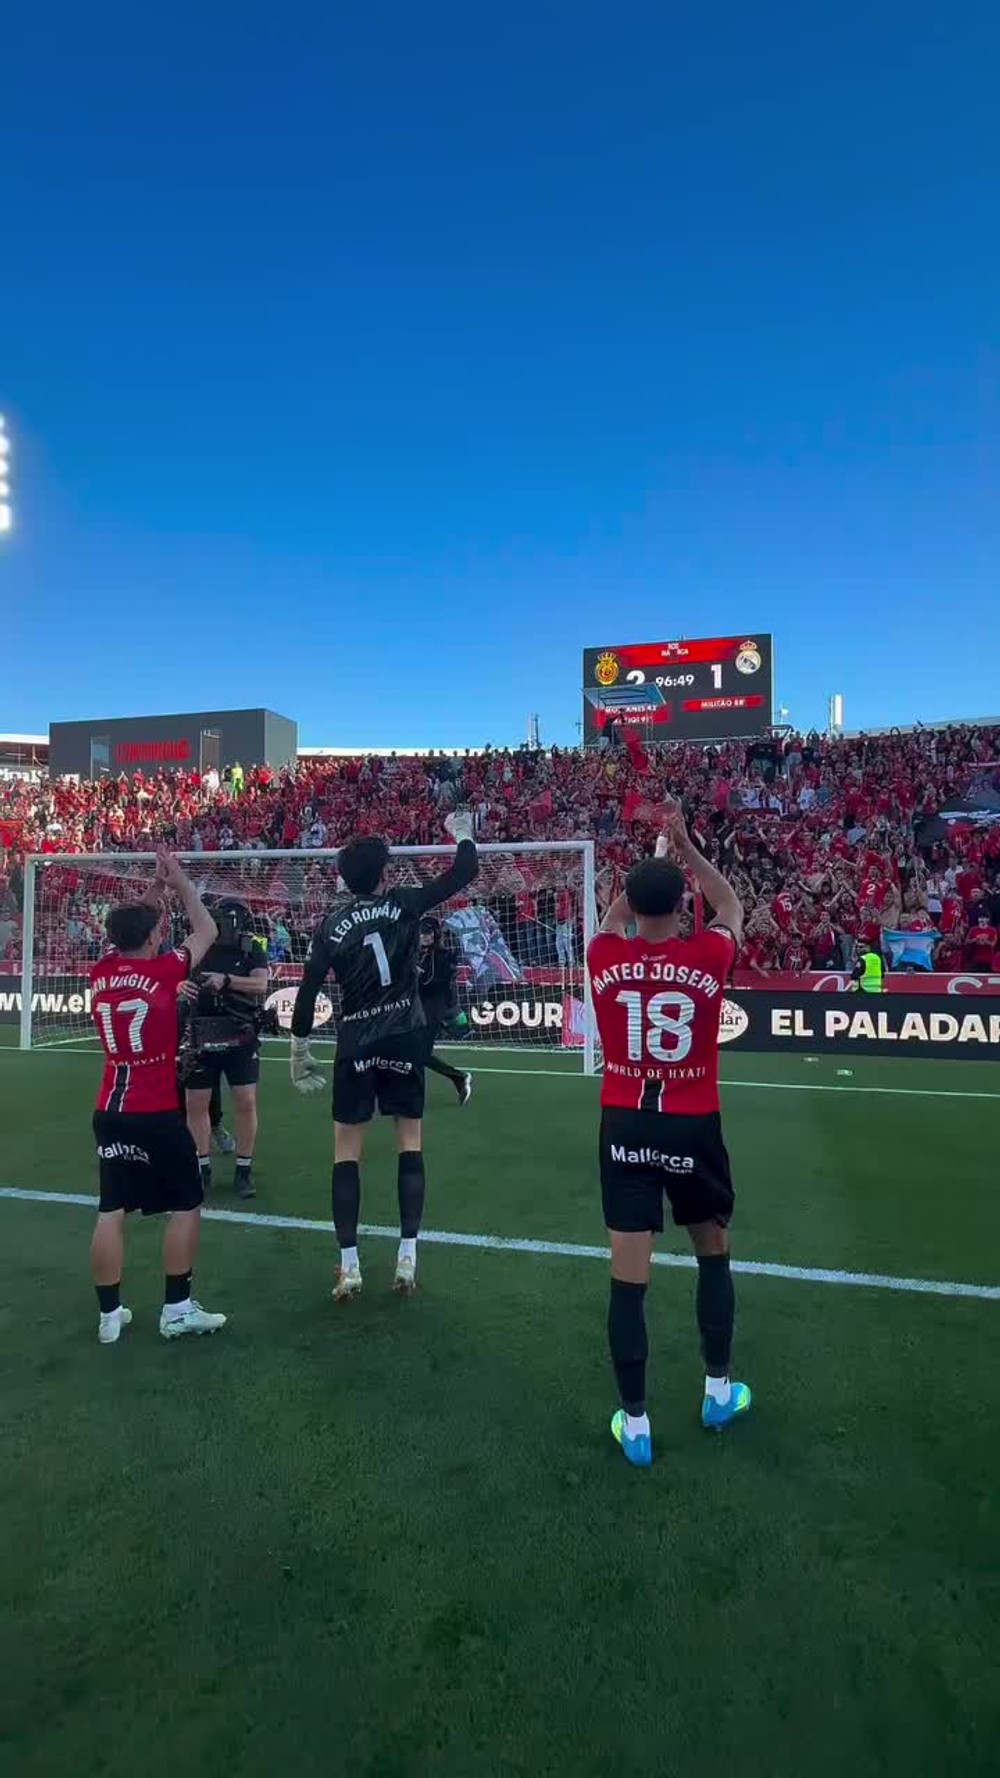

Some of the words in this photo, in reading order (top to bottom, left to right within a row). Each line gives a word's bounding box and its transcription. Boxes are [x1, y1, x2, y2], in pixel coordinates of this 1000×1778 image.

[655, 674, 695, 687] 96:49
[711, 664, 722, 689] 1
[867, 883, 876, 895] 2
[779, 898, 792, 911] 15
[330, 918, 352, 944] LEO
[363, 931, 392, 987] 1
[593, 962, 645, 995] MATEO
[650, 963, 720, 998] JOSEPH
[0, 989, 94, 1020] www.el
[96, 998, 149, 1053] 17
[615, 989, 696, 1063] 18
[771, 1009, 814, 1036] EL
[354, 1057, 412, 1073] Mallorca
[606, 1061, 641, 1078] WORLD
[647, 1068, 663, 1079] OF
[611, 1144, 694, 1168] Mallorca
